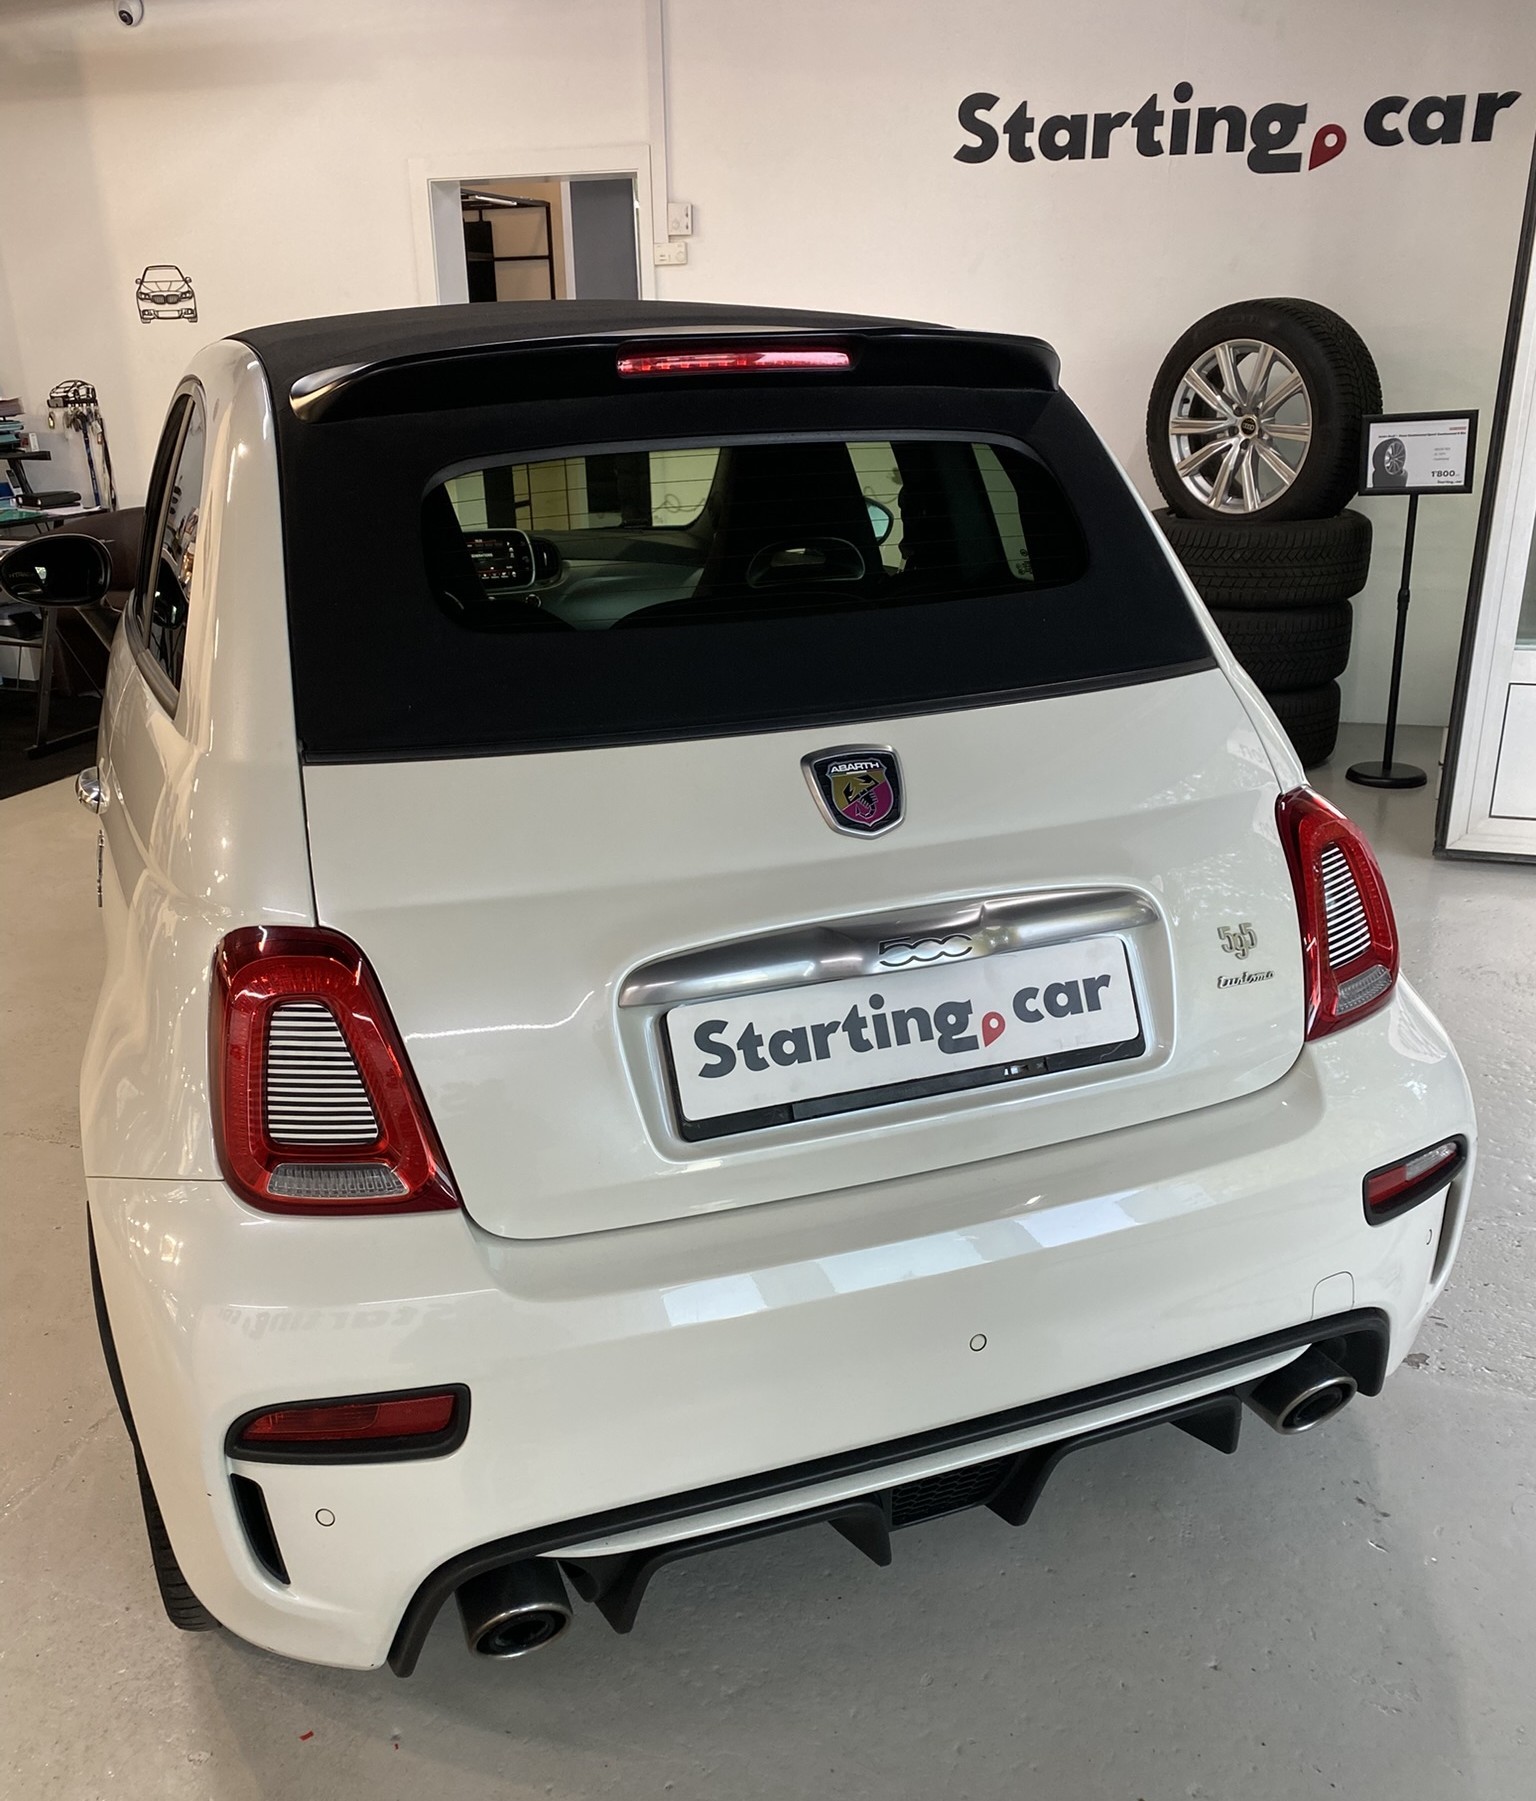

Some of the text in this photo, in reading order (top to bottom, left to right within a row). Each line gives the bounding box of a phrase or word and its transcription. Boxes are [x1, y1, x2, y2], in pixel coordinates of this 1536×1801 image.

[953, 81, 1522, 174] Starting car
[831, 762, 880, 773] ABARTH
[879, 932, 973, 967] 500
[1217, 922, 1257, 960] 595
[694, 973, 1111, 1079] Starting car
